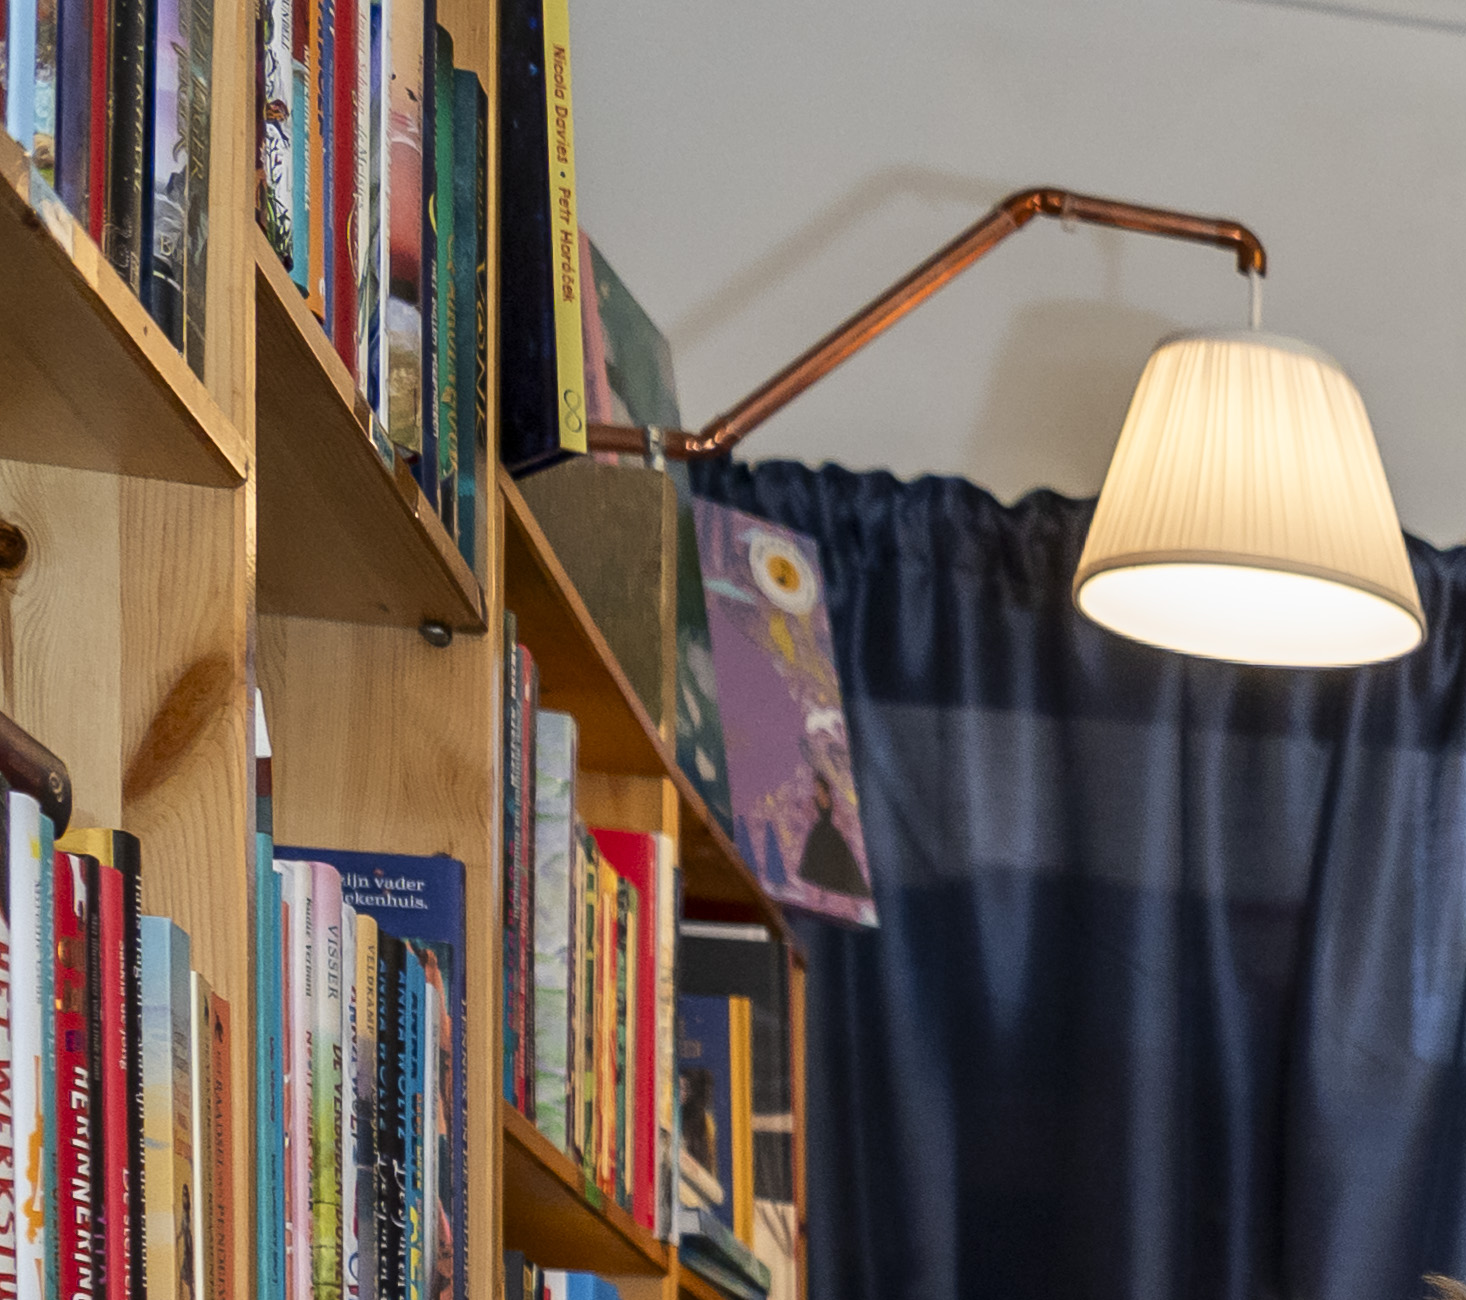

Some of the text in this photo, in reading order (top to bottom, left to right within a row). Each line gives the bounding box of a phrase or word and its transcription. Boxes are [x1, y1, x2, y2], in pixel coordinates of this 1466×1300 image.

[553, 44, 566, 99] Nicola
[556, 105, 569, 164] Davies
[558, 186, 571, 226] Petr
[374, 874, 426, 893] vader
[328, 924, 338, 1000] VISSER
[366, 944, 375, 1036] VELDKAMP
[379, 959, 387, 1032] ANNA
[397, 969, 406, 1043] ANNA
[333, 1044, 342, 1070] DE
[334, 1083, 342, 1197] VERBODEN
